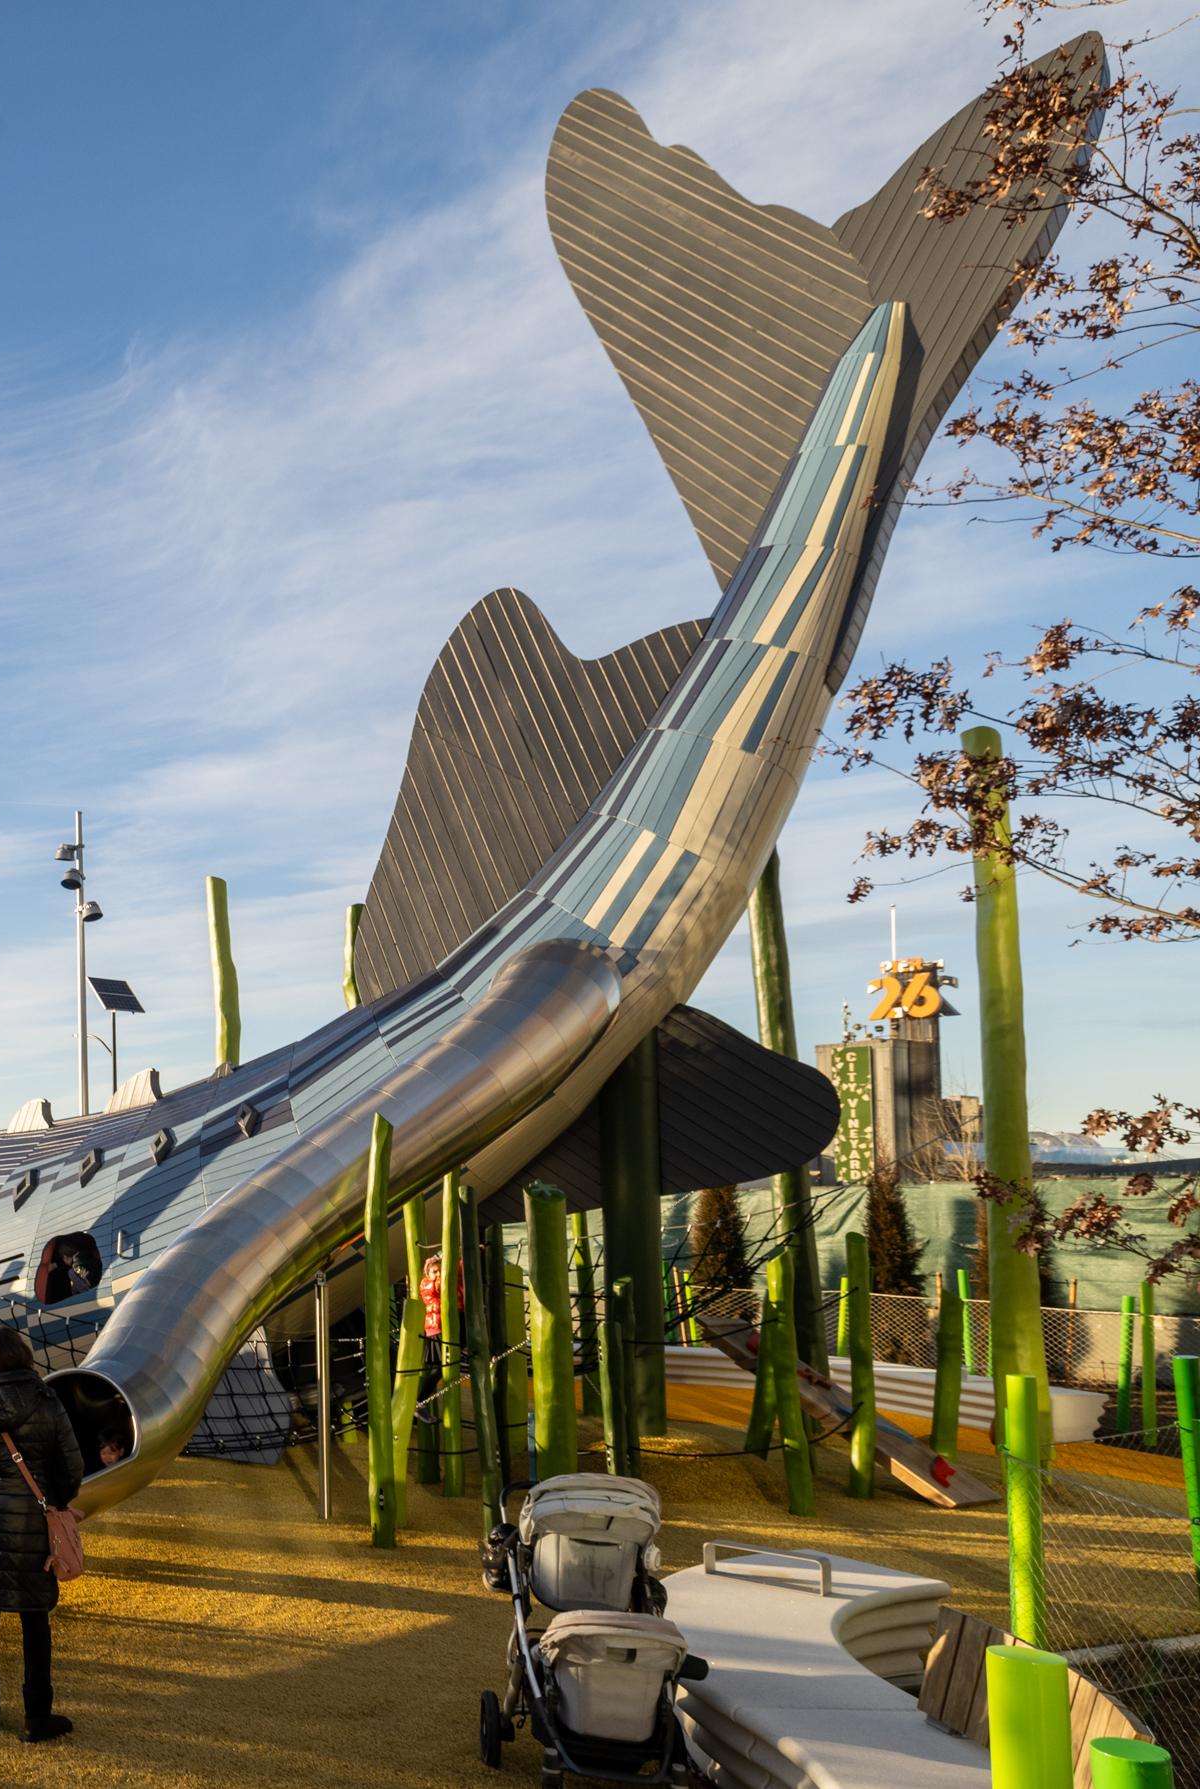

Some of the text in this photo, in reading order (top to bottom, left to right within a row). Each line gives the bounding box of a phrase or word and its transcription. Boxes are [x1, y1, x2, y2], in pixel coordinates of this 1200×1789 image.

[879, 957, 923, 973] PIER
[866, 972, 940, 1020] 26
[845, 1051, 861, 1180] CITY VINEYARD
